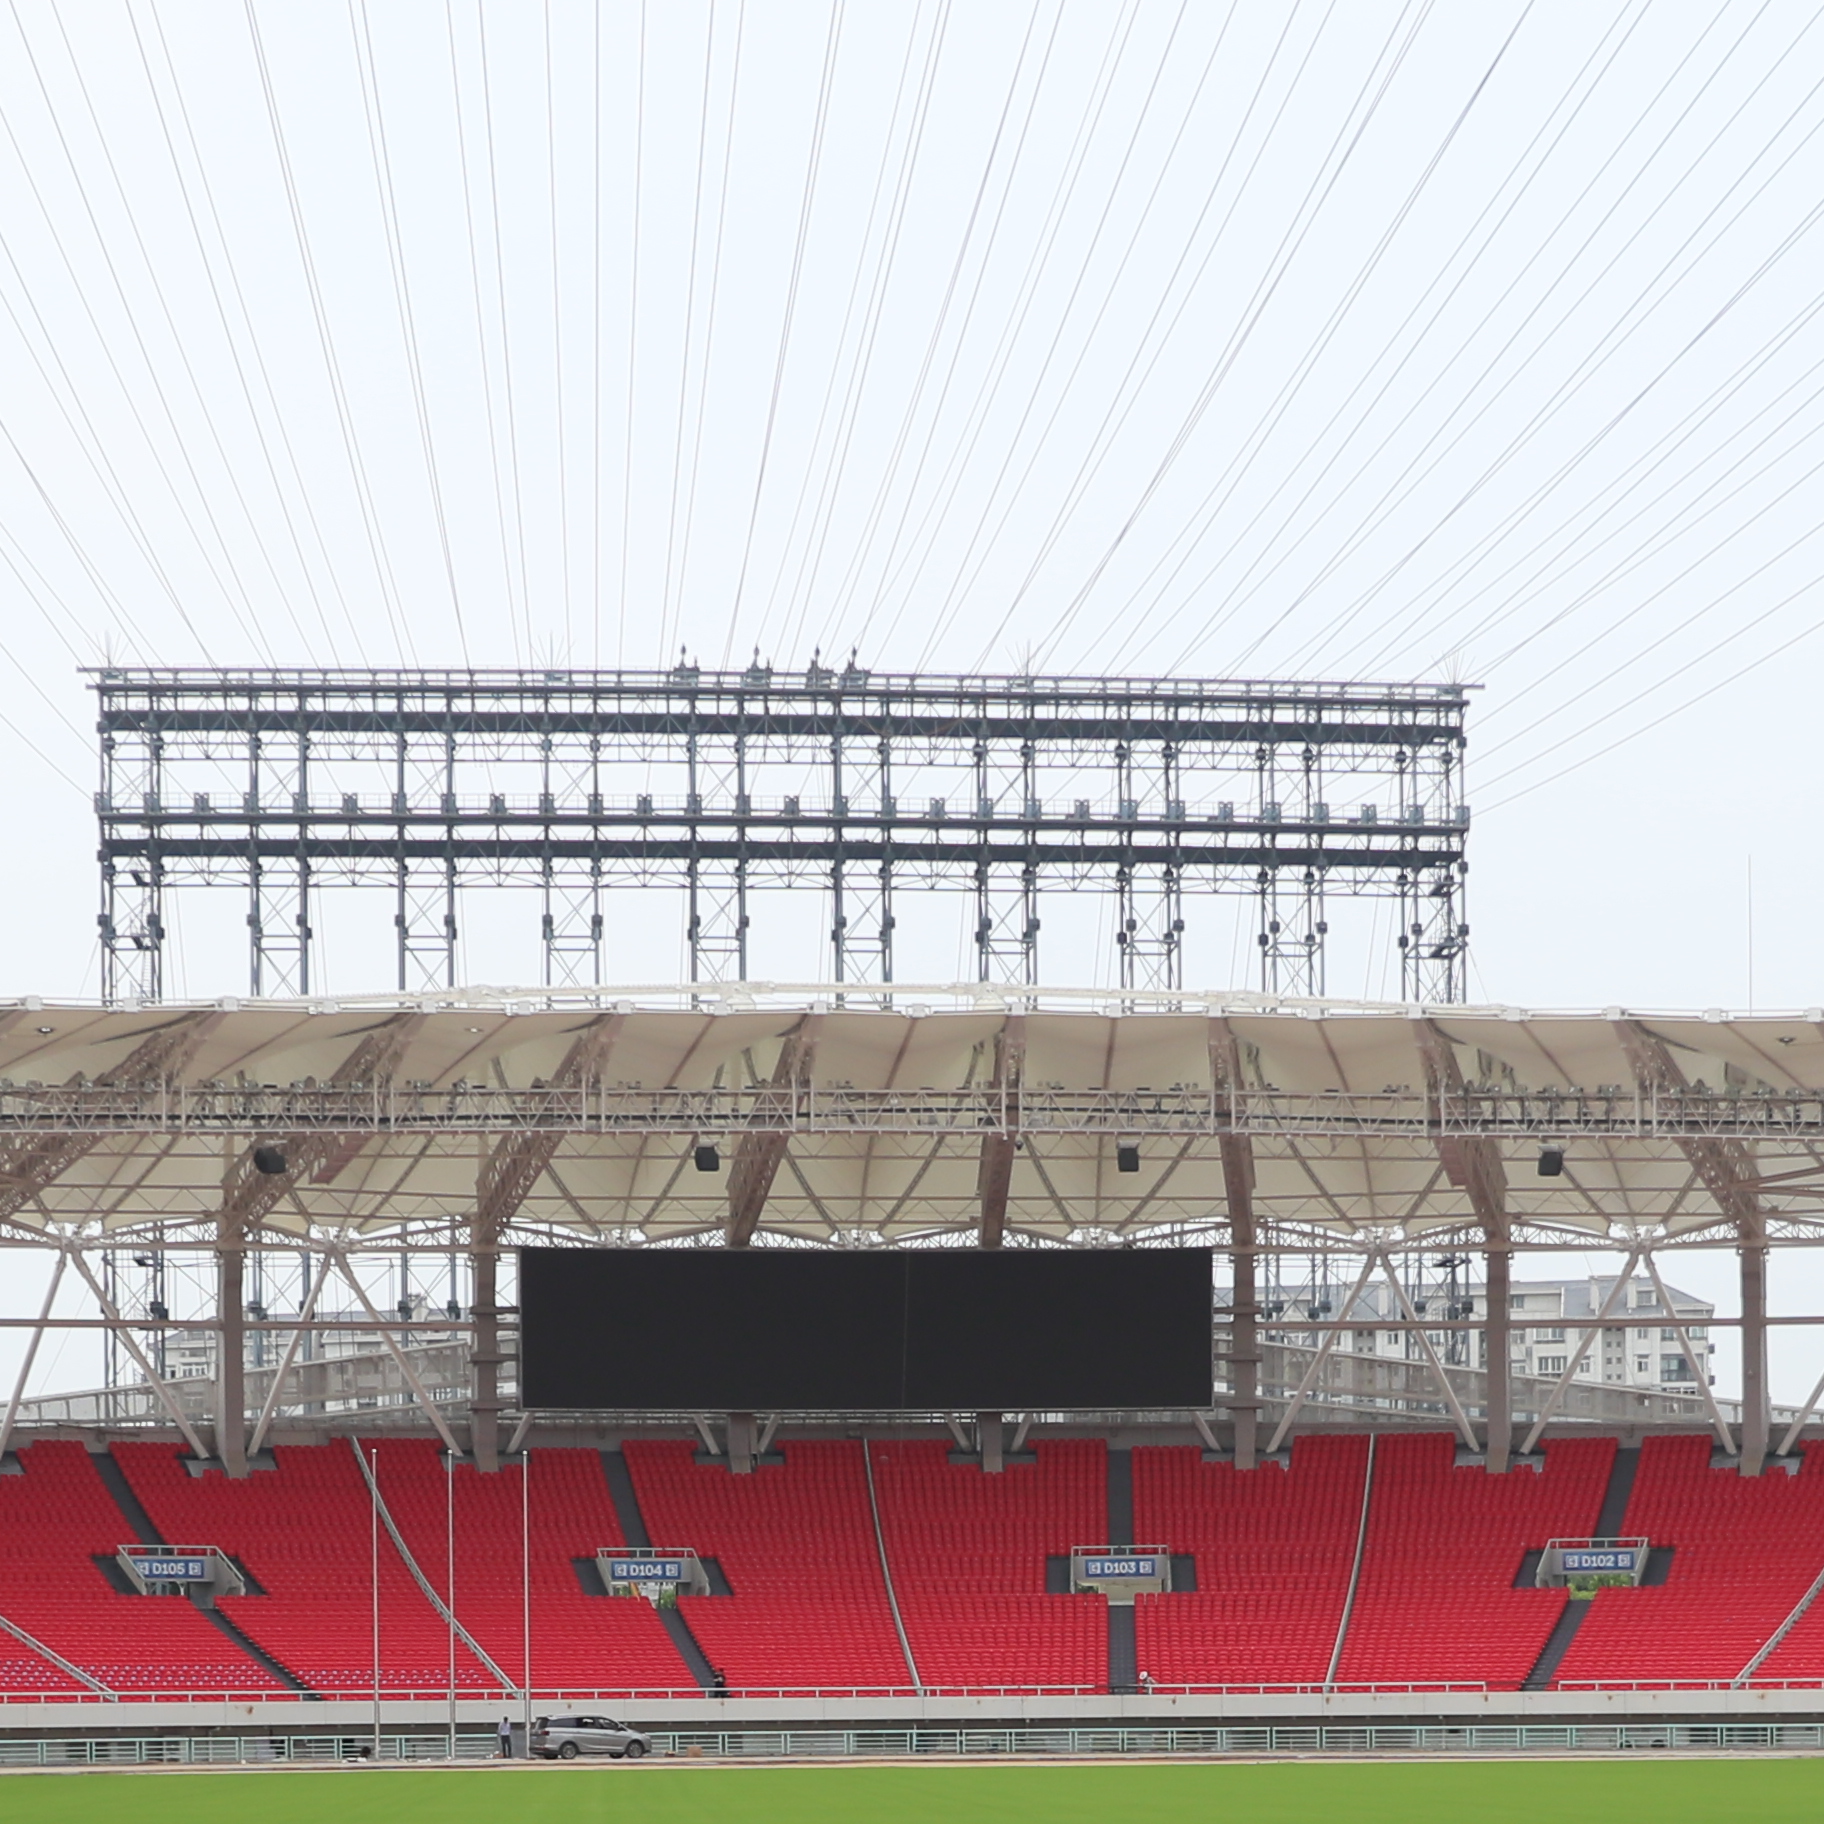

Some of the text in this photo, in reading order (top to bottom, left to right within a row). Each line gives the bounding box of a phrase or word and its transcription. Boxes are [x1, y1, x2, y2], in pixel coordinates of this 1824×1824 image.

[1581, 1554, 1615, 1567] D102
[152, 1562, 185, 1575] D105
[629, 1564, 662, 1577] D104
[1104, 1561, 1136, 1574] D103
